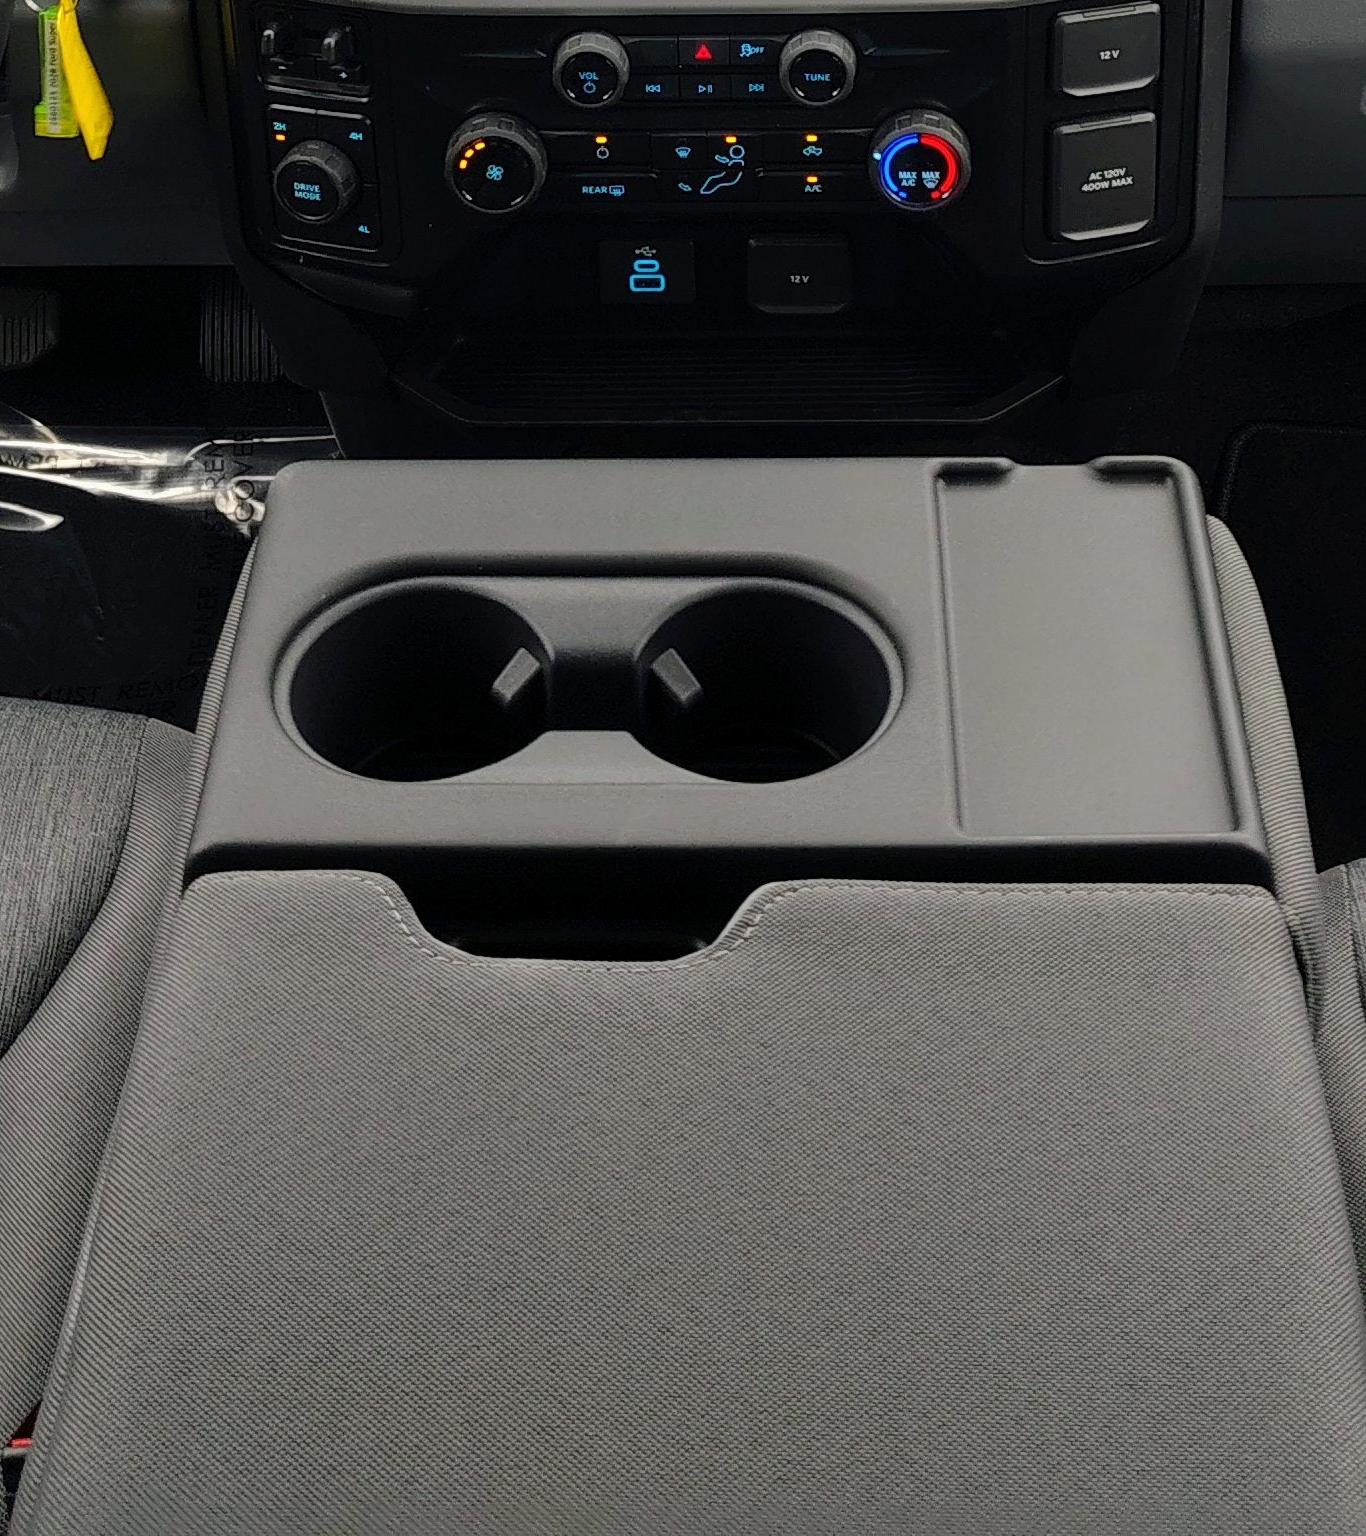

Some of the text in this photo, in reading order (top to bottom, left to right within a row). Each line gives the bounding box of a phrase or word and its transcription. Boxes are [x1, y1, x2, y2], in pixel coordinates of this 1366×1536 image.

[750, 46, 765, 54] OFF
[1099, 49, 1120, 60] 12 V
[578, 71, 599, 80] VOL
[804, 72, 831, 82] TUNE
[898, 170, 918, 179] MAX
[921, 170, 941, 179] MAX
[1089, 167, 1128, 181] AC 120V
[293, 181, 322, 193] DRIVE
[900, 178, 917, 187] A/C
[1081, 176, 1134, 193] 400W MAX
[581, 185, 608, 195] REAR
[804, 184, 823, 194] A/C
[294, 190, 322, 202] MODE
[357, 224, 371, 234] 4L
[790, 274, 810, 284] 12 V
